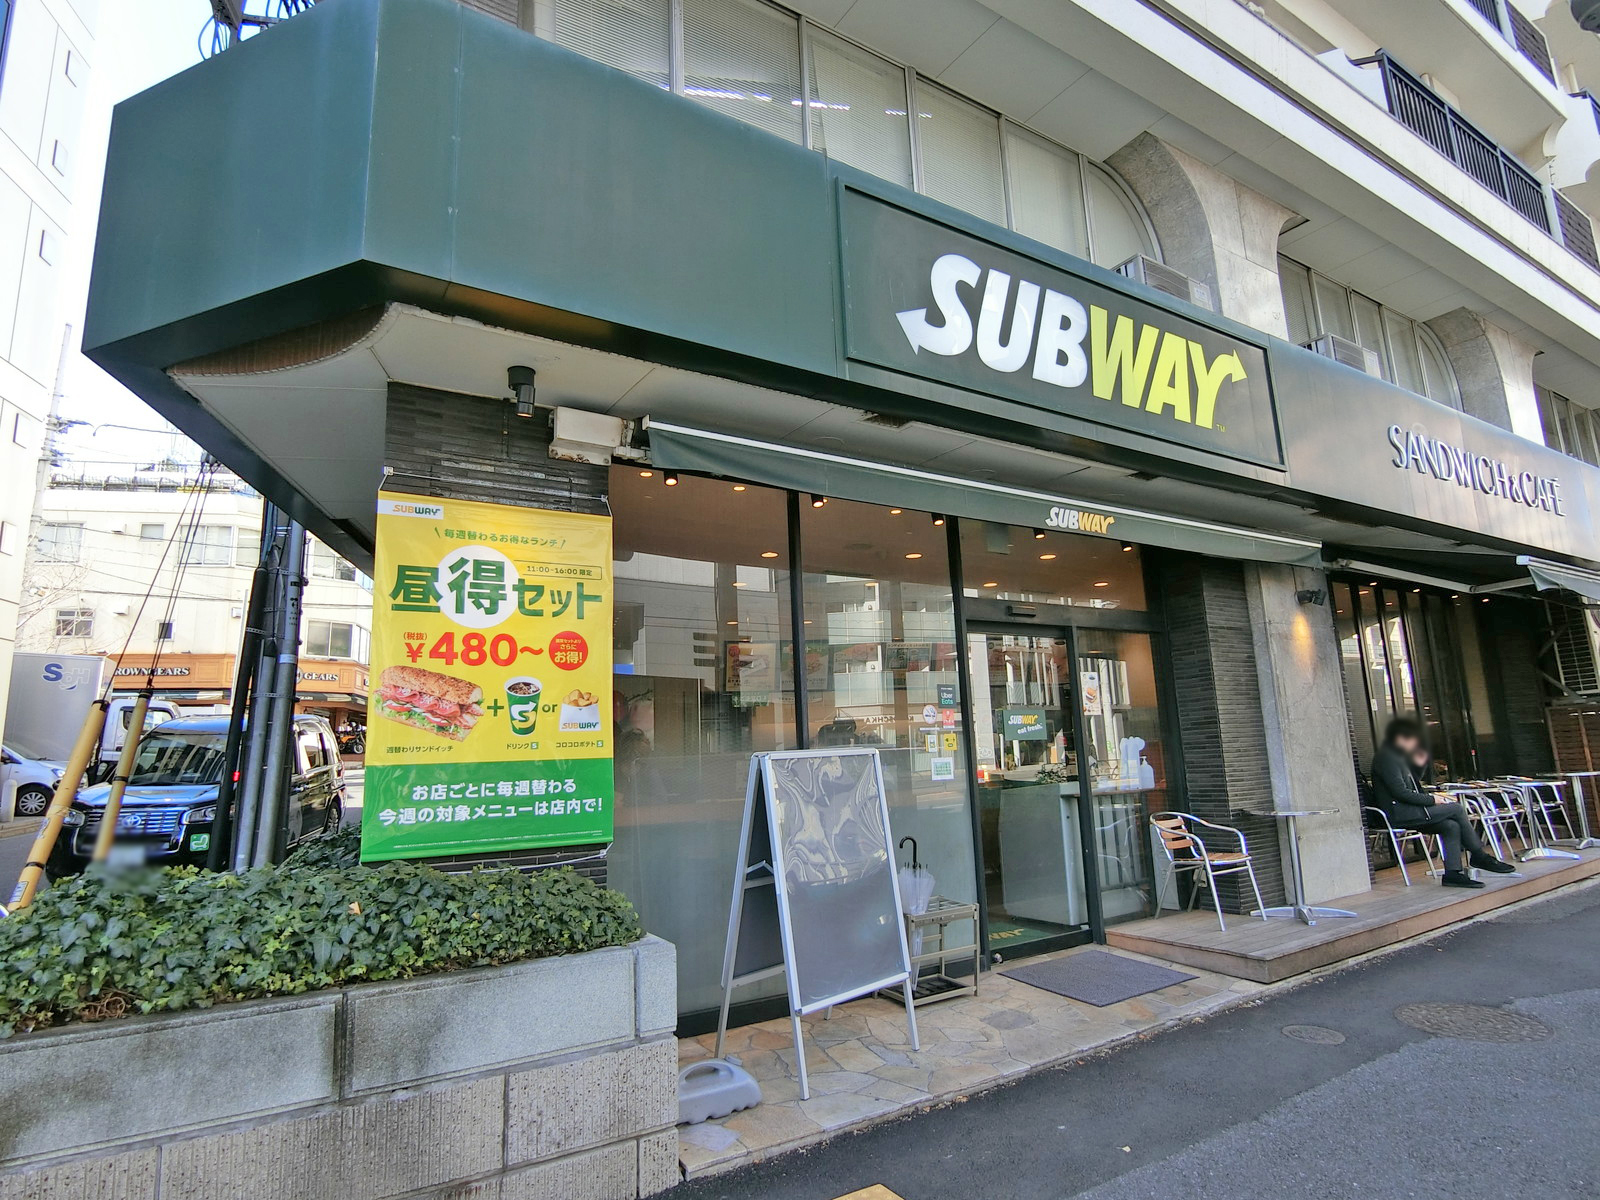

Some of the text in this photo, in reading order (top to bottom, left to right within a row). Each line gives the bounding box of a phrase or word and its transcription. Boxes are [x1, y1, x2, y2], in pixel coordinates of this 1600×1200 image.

[895, 253, 1248, 429] SUBWAY
[392, 504, 441, 516] SUBWAY
[1045, 506, 1115, 534] SUBWAY
[444, 528, 558, 548] 毎週替わるお得なランチ
[389, 557, 602, 620] 昼得セット
[554, 651, 583, 664] お得!
[114, 667, 148, 676] ROWN
[304, 672, 339, 681] GEARS
[542, 701, 558, 714] or
[1008, 714, 1039, 725] SUBWAY
[561, 721, 600, 730] SUBWAY
[1017, 726, 1027, 735] eat
[386, 745, 454, 754] 週替わりサンドイッチ
[506, 742, 529, 750] ドリンク
[555, 740, 596, 749] コロコロポテト
[412, 778, 577, 801] お店ごとに毎週替わる
